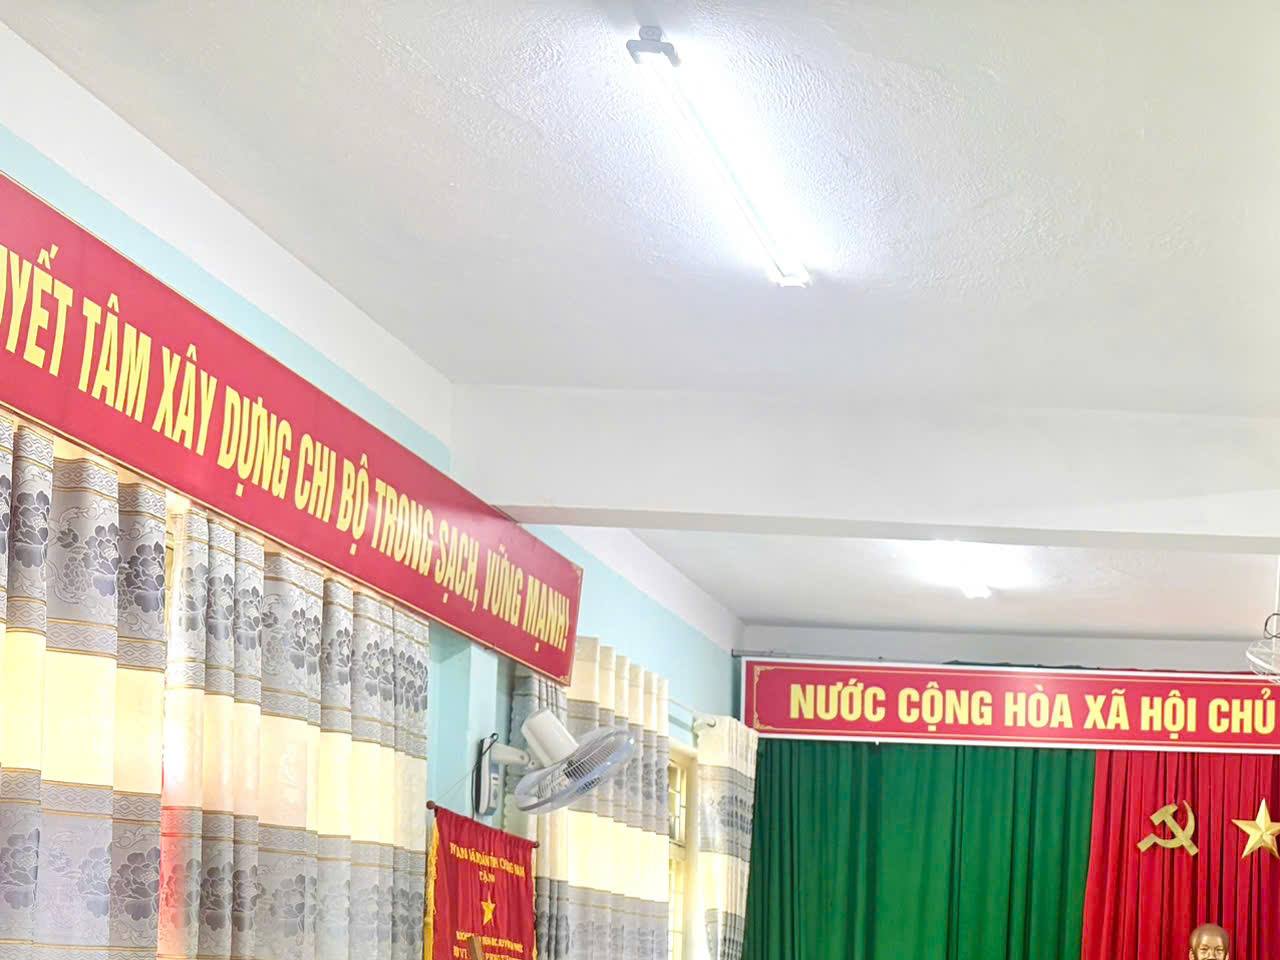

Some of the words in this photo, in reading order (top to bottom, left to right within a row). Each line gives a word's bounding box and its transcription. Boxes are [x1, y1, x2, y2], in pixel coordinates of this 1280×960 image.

[78, 293, 152, 423] TÂM
[152, 344, 218, 456] XÂY
[217, 385, 292, 499] DỰNG
[294, 433, 336, 523] CHI
[336, 453, 369, 555] BỘ
[371, 478, 434, 576] TRONG
[434, 520, 480, 612] SẠCH,
[483, 543, 524, 627] VỮNG
[522, 575, 570, 652] MẠNH!
[789, 677, 886, 723] NƯỚC
[898, 681, 993, 732] CỘNG
[1004, 684, 1074, 728] HÒA
[1083, 685, 1130, 731] XÃ
[1141, 687, 1197, 739] HỘI
[1208, 686, 1276, 734] CHỦ
